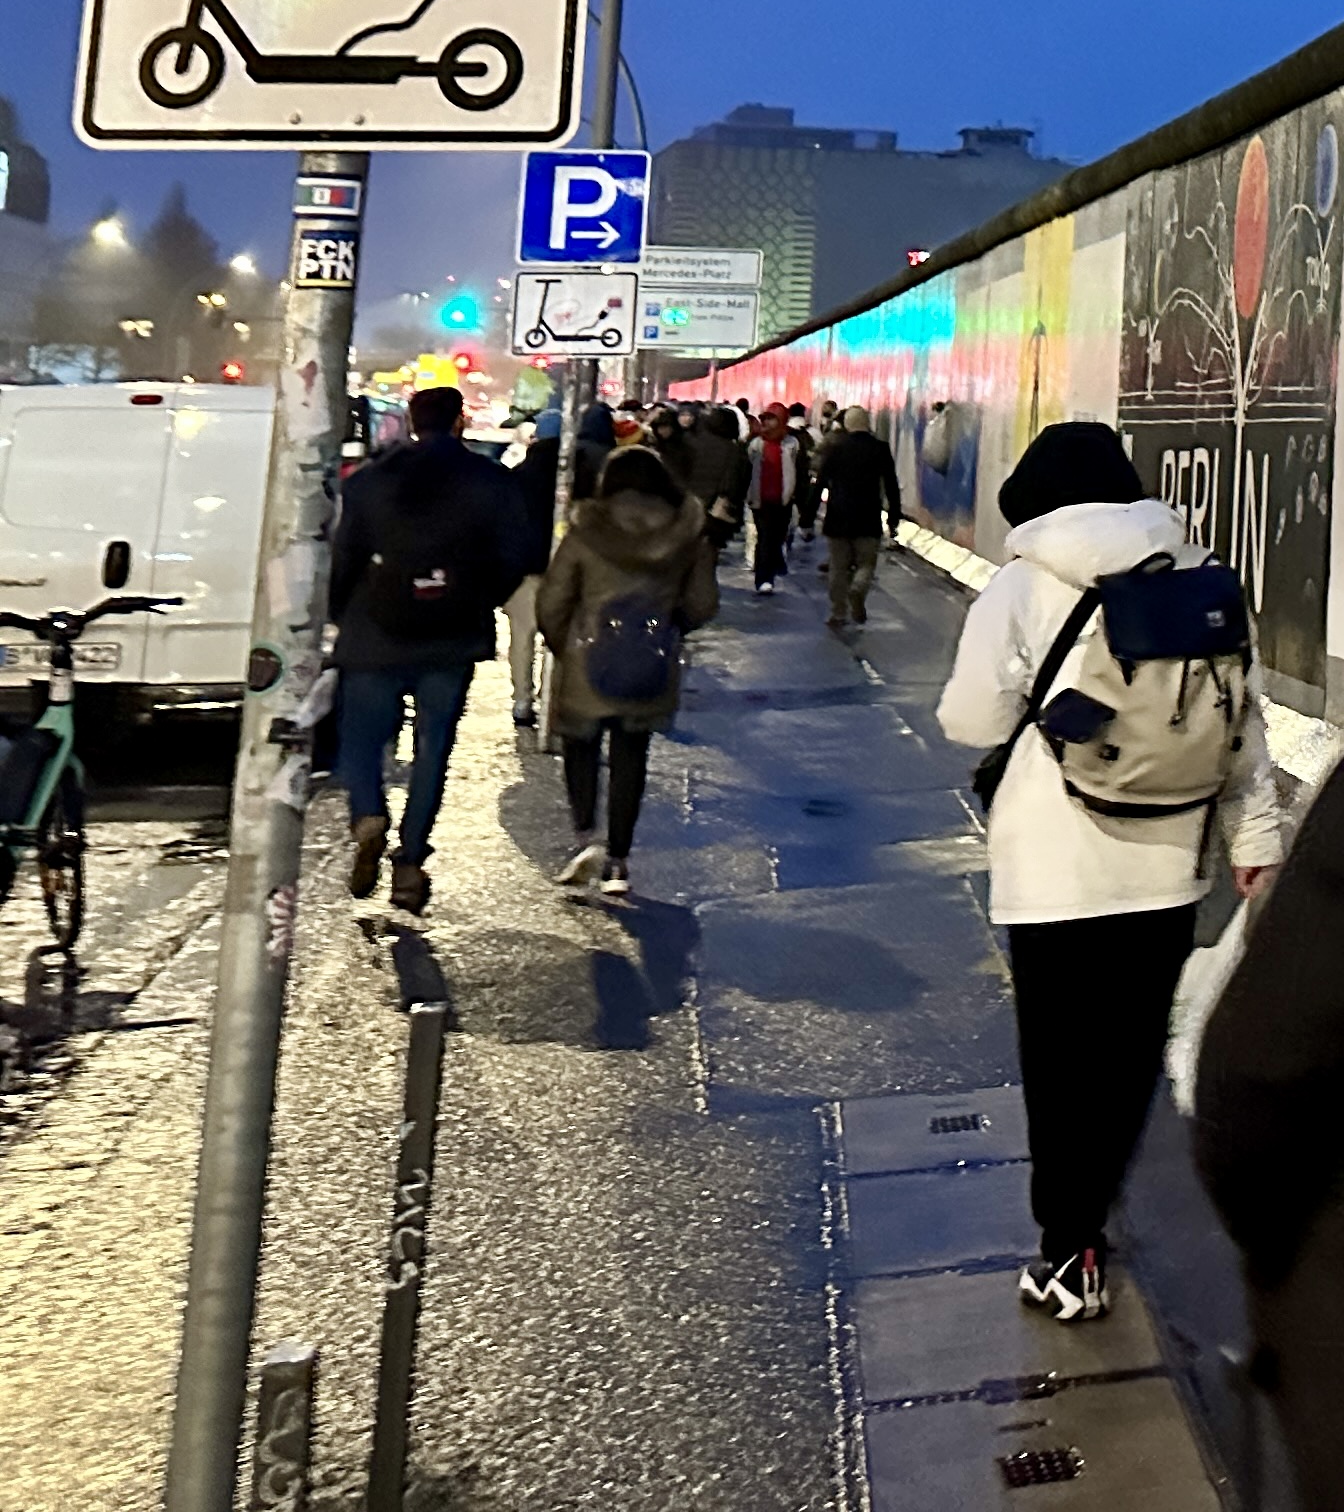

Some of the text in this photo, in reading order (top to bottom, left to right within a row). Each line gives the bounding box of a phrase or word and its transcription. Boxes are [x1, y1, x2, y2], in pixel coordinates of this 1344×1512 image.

[549, 165, 619, 250] P
[301, 239, 356, 260] FCK
[299, 259, 356, 280] PTN
